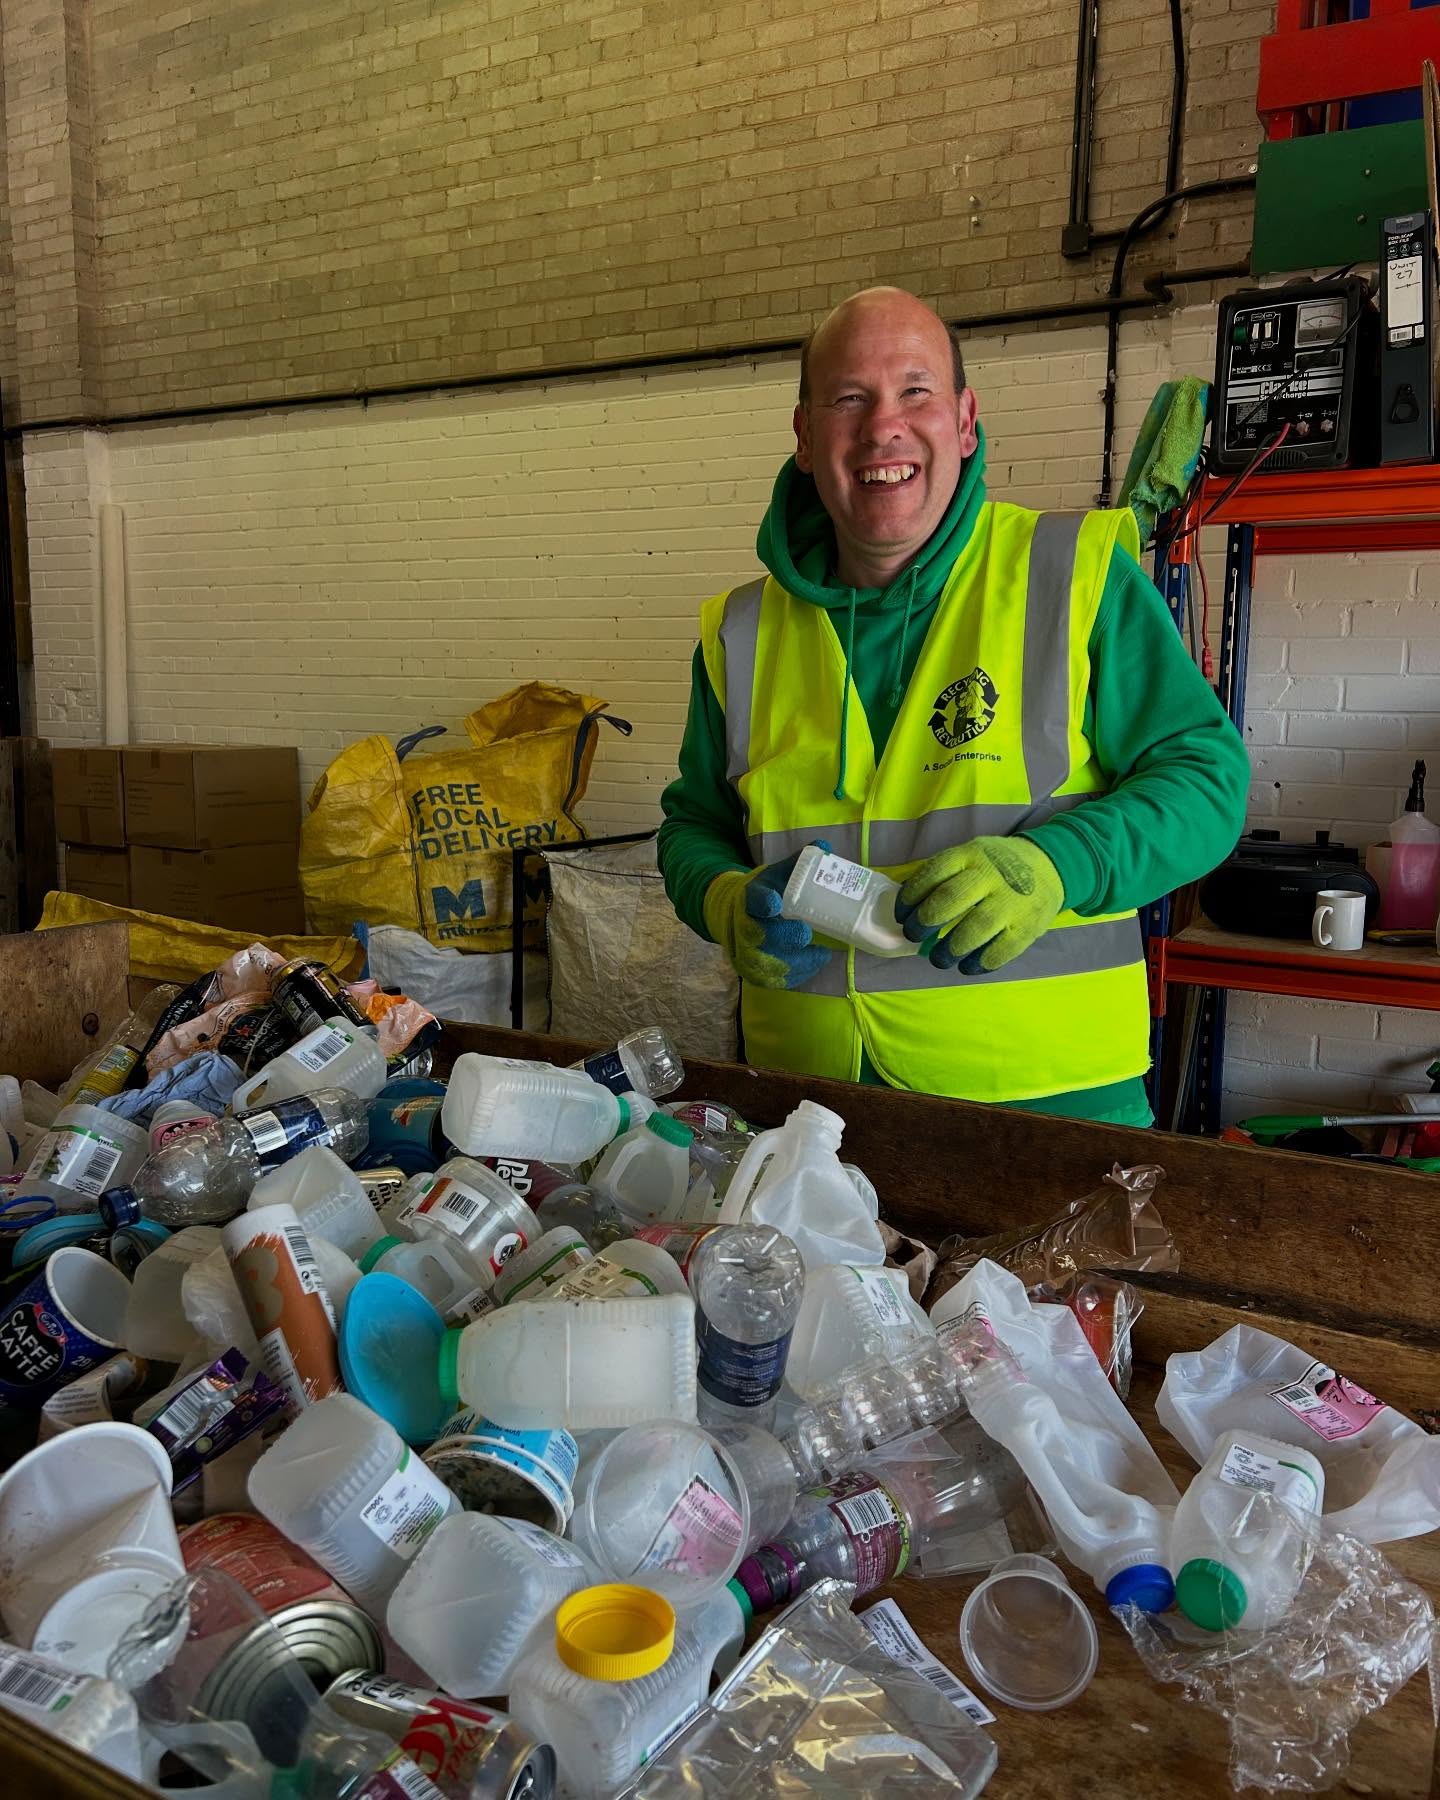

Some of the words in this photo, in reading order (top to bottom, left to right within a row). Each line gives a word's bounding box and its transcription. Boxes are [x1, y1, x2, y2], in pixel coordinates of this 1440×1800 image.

[954, 752, 1002, 762] Enterprise
[411, 783, 484, 816] FREE
[418, 807, 511, 835] LOCAL
[362, 1494, 384, 1518] 500ml
